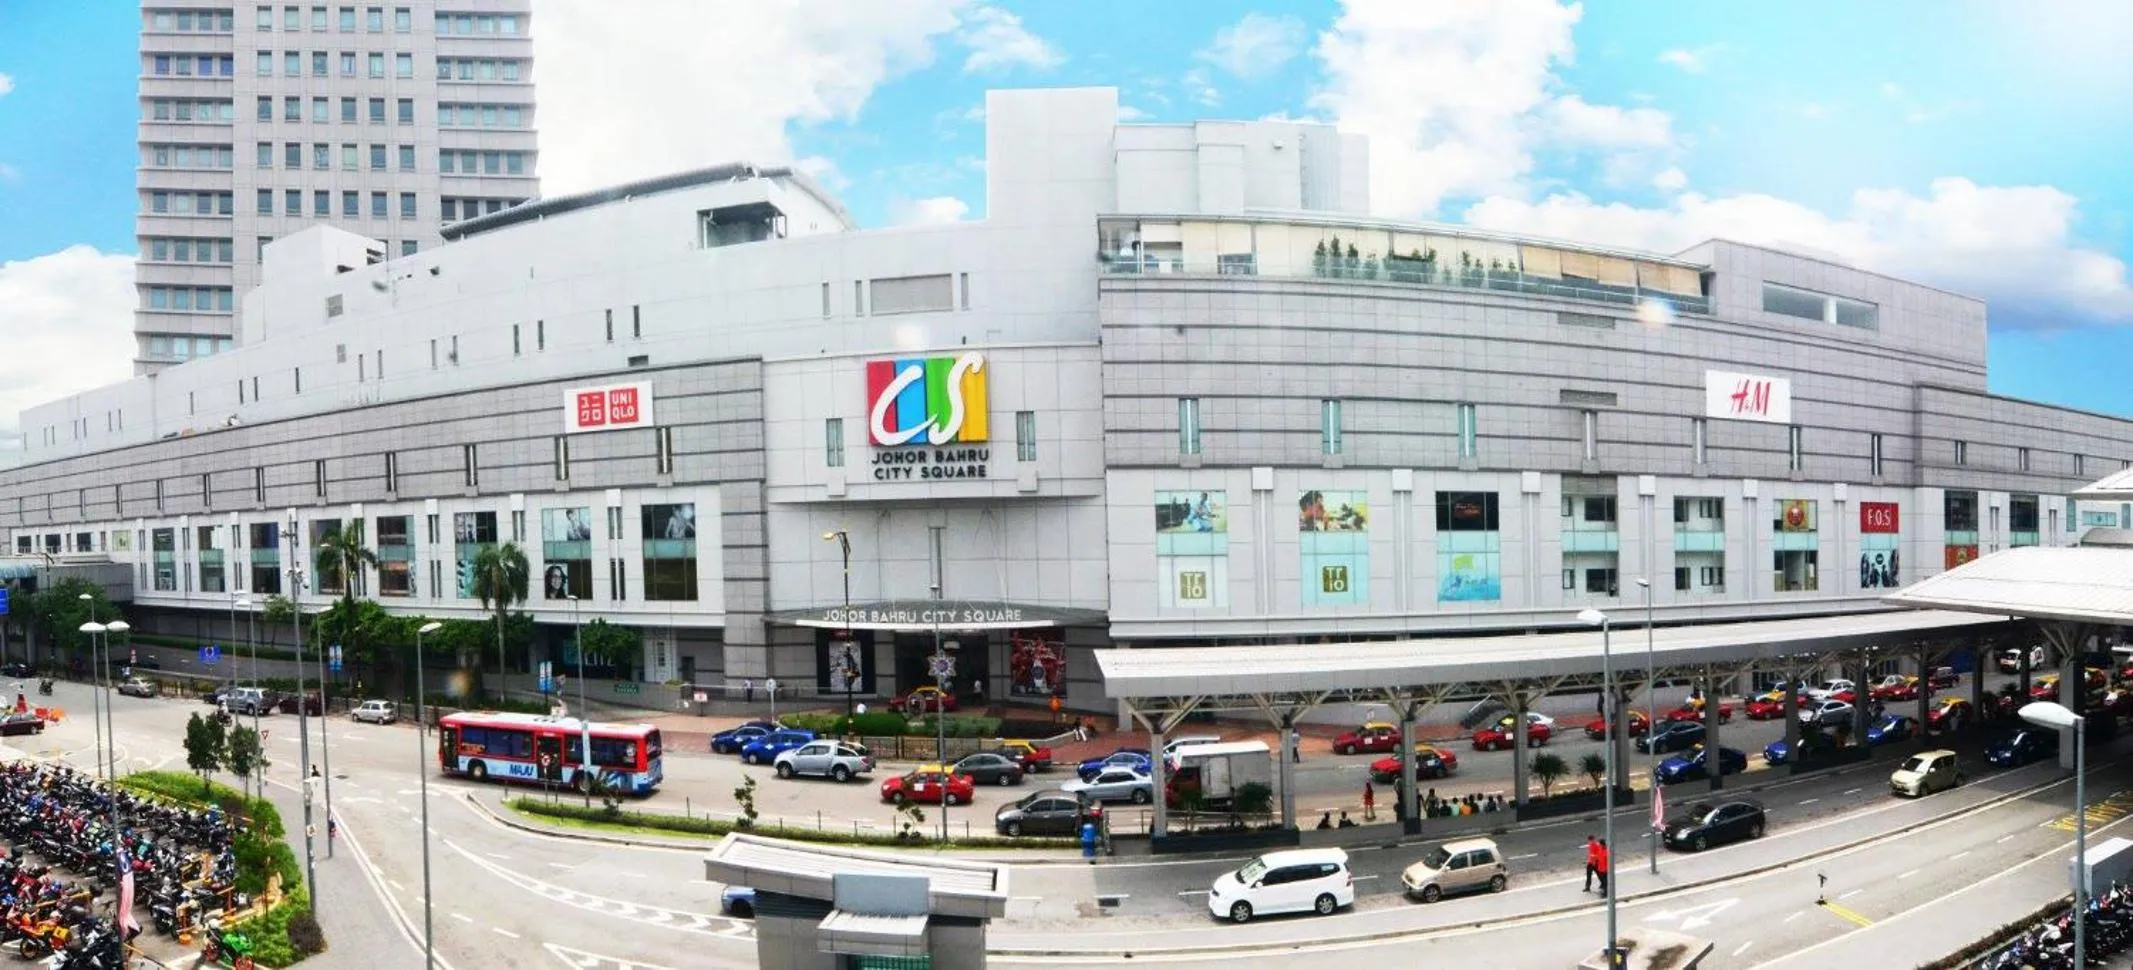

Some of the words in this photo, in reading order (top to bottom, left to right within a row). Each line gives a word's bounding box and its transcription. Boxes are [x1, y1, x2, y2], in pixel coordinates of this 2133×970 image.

[1730, 378, 1771, 416] H&M
[871, 450, 927, 465] JOHOR
[935, 448, 989, 462] BAHRU
[874, 466, 912, 480] CITY
[920, 465, 987, 478] SQUARE
[823, 609, 867, 622] JOHOR
[871, 609, 917, 622] BAHRU
[922, 610, 957, 622] CITY
[963, 609, 1022, 622] SQUARE
[509, 764, 534, 776] MAJU
